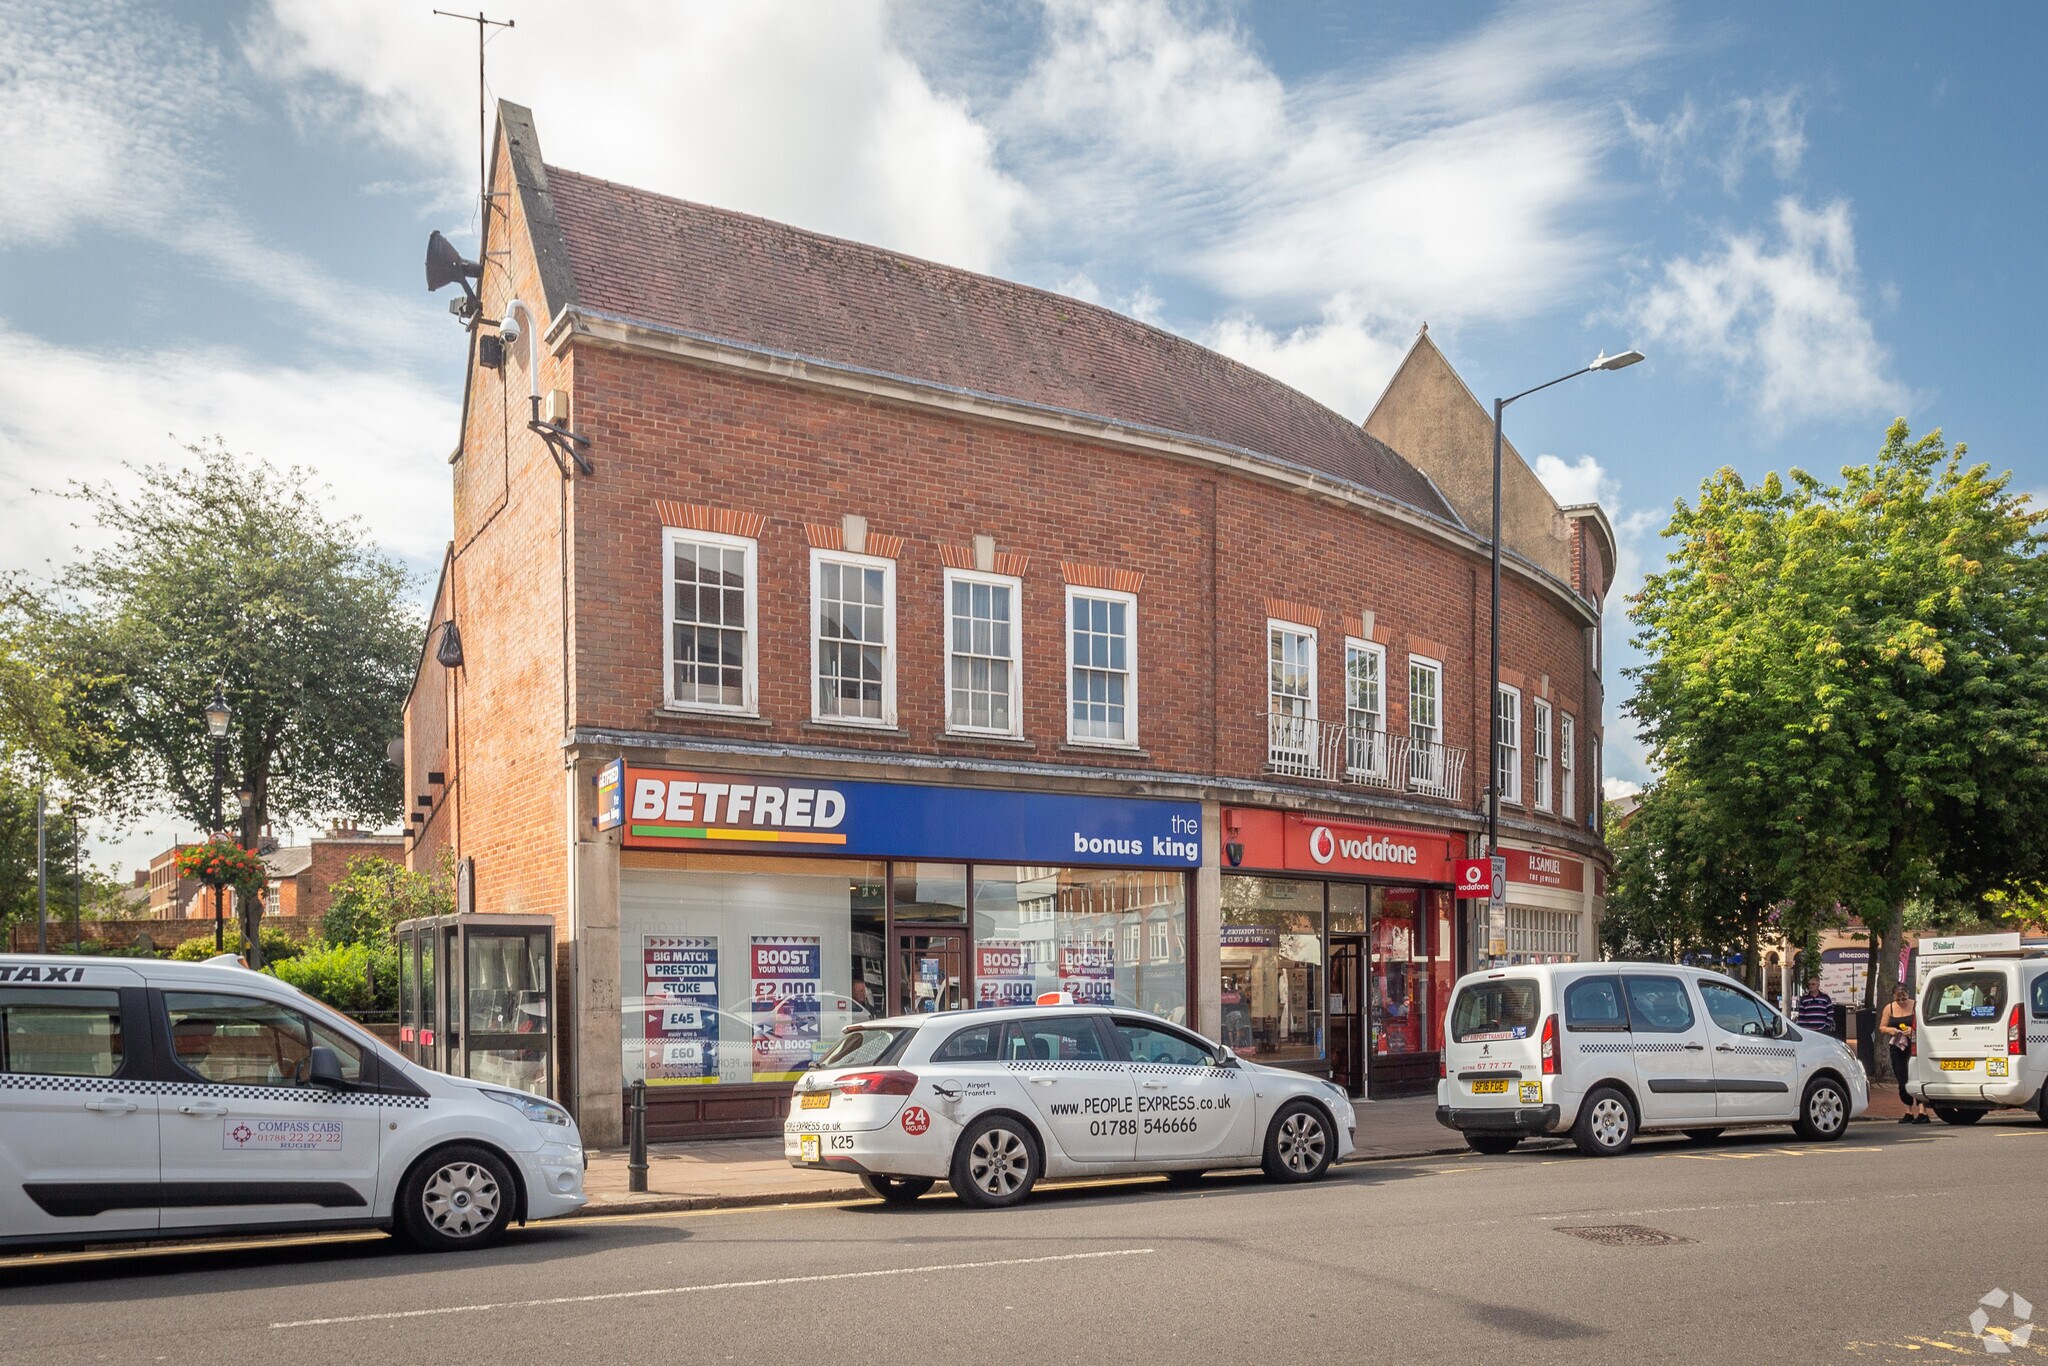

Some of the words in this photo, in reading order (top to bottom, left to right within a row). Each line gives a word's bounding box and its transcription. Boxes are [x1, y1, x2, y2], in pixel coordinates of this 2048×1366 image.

[632, 778, 846, 828] BETFRED
[1171, 814, 1198, 834] the
[1074, 832, 1142, 855] bonus
[1152, 836, 1198, 861] king
[1339, 834, 1417, 864] vodafone
[1458, 882, 1490, 891] vodafone
[654, 952, 670, 962] BIG
[672, 952, 708, 962] MATCH
[758, 950, 810, 965] BOOST
[983, 953, 1028, 966] BOOST
[1065, 953, 1108, 966] BOOST
[0, 966, 86, 982] TAXI
[655, 965, 708, 975] PRESTON
[758, 966, 776, 974] YOUR
[778, 966, 810, 974] WINNINGS
[664, 983, 700, 993] STOKE
[980, 983, 1032, 998] £2,000
[1063, 982, 1112, 997] £2,000
[670, 1013, 694, 1024] £45
[1488, 1032, 1512, 1040] TRANSFER
[755, 1040, 782, 1050] ACCA
[671, 1048, 694, 1058] £60
[1944, 1060, 1957, 1068] SF15
[1958, 1060, 1971, 1068] EXP
[967, 1082, 990, 1090] Airport
[1050, 1097, 1133, 1115] www.PEOPLE
[1138, 1094, 1231, 1112] EXPRESS.co.uk
[904, 1108, 926, 1126] 24
[258, 1122, 310, 1132] COMPASS
[312, 1122, 340, 1132] CABS
[1090, 1120, 1137, 1136] 01788
[1144, 1117, 1198, 1134] 546666
[258, 1134, 286, 1142] 01788
[289, 1132, 304, 1142] 22
[308, 1133, 322, 1142] 22
[326, 1134, 340, 1142] 22
[830, 1135, 854, 1150] K25
